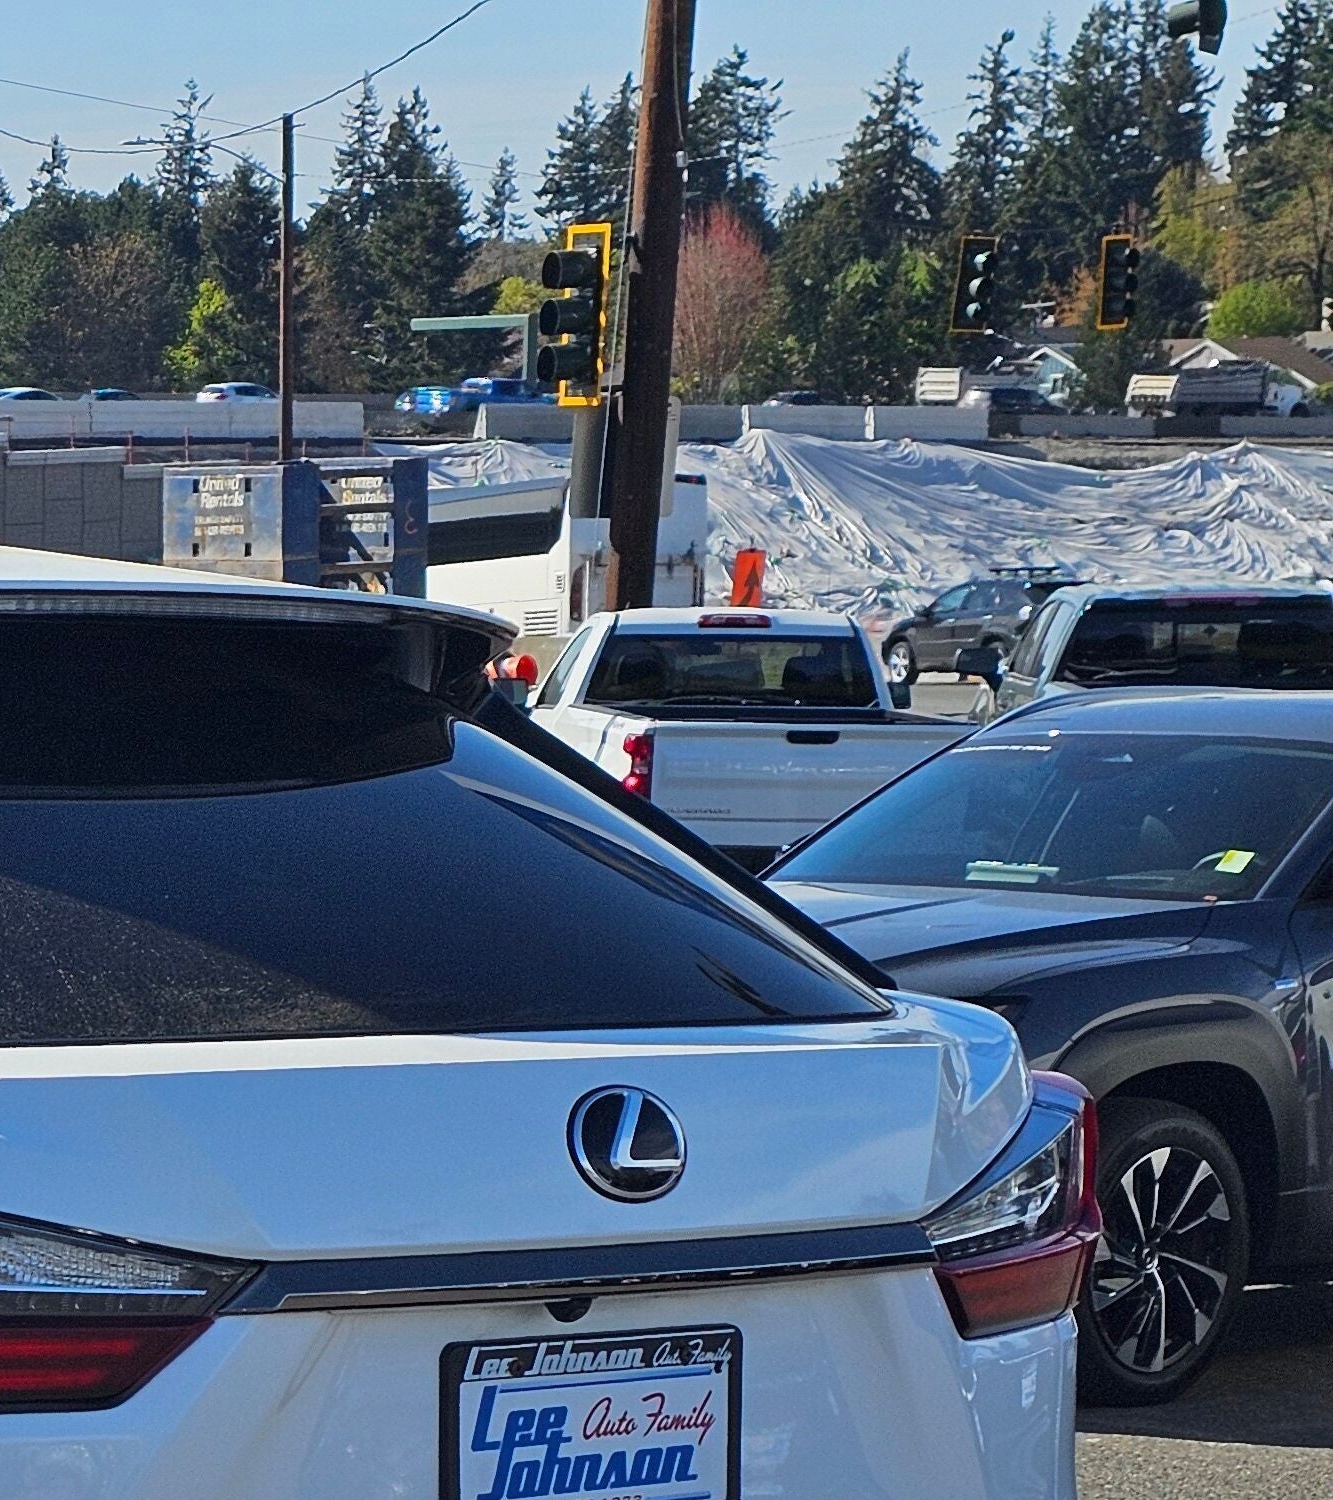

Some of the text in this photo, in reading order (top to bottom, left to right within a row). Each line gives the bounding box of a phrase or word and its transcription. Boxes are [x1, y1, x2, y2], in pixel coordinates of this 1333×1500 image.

[524, 1341, 645, 1375] Johnson
[653, 1341, 683, 1367] Aut
[688, 1338, 732, 1364] Family
[471, 1385, 716, 1452] Lee Auto Family
